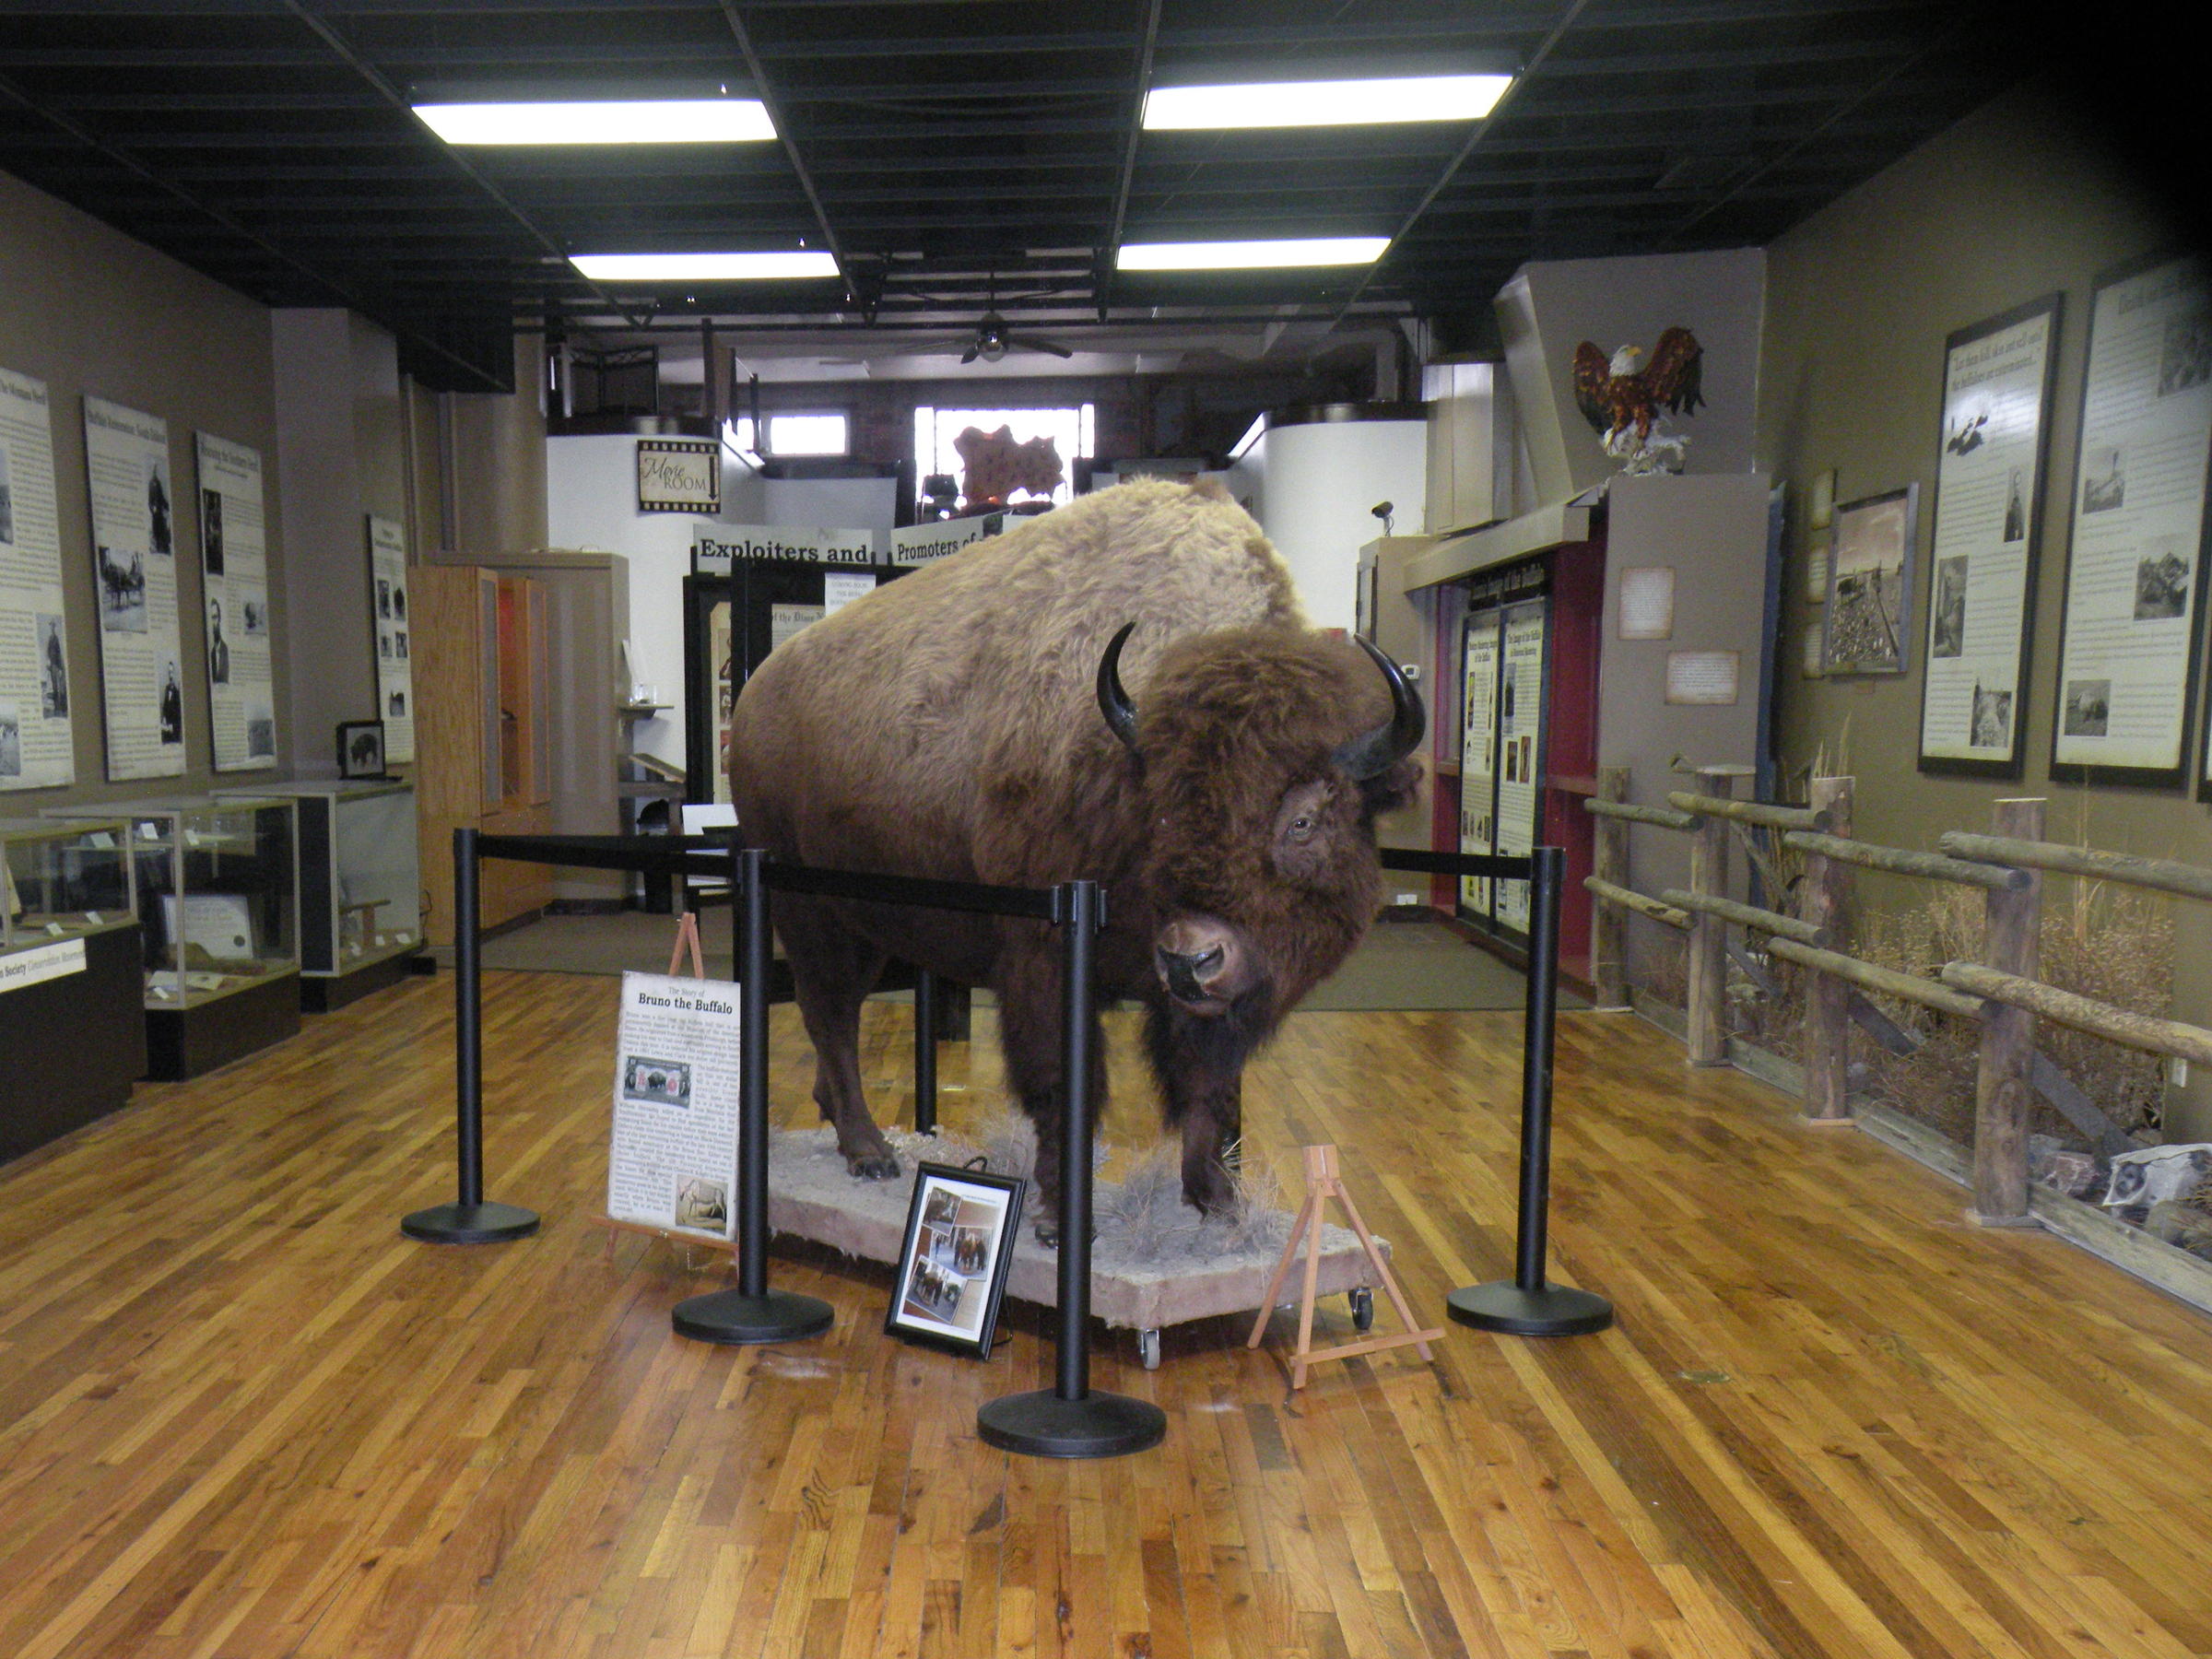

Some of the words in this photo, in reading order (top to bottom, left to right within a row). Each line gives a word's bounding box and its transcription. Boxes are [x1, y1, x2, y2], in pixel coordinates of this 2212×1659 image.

[641, 457, 686, 480] Movie
[664, 477, 707, 491] ROOM
[700, 538, 819, 563] Exploiters
[827, 544, 870, 563] and
[897, 539, 961, 562] Promoters
[5, 962, 27, 977] Society
[668, 986, 679, 995] The
[699, 989, 705, 997] of
[639, 993, 671, 1007] Bruno
[675, 997, 691, 1010] the
[695, 999, 733, 1015] Buffalo
